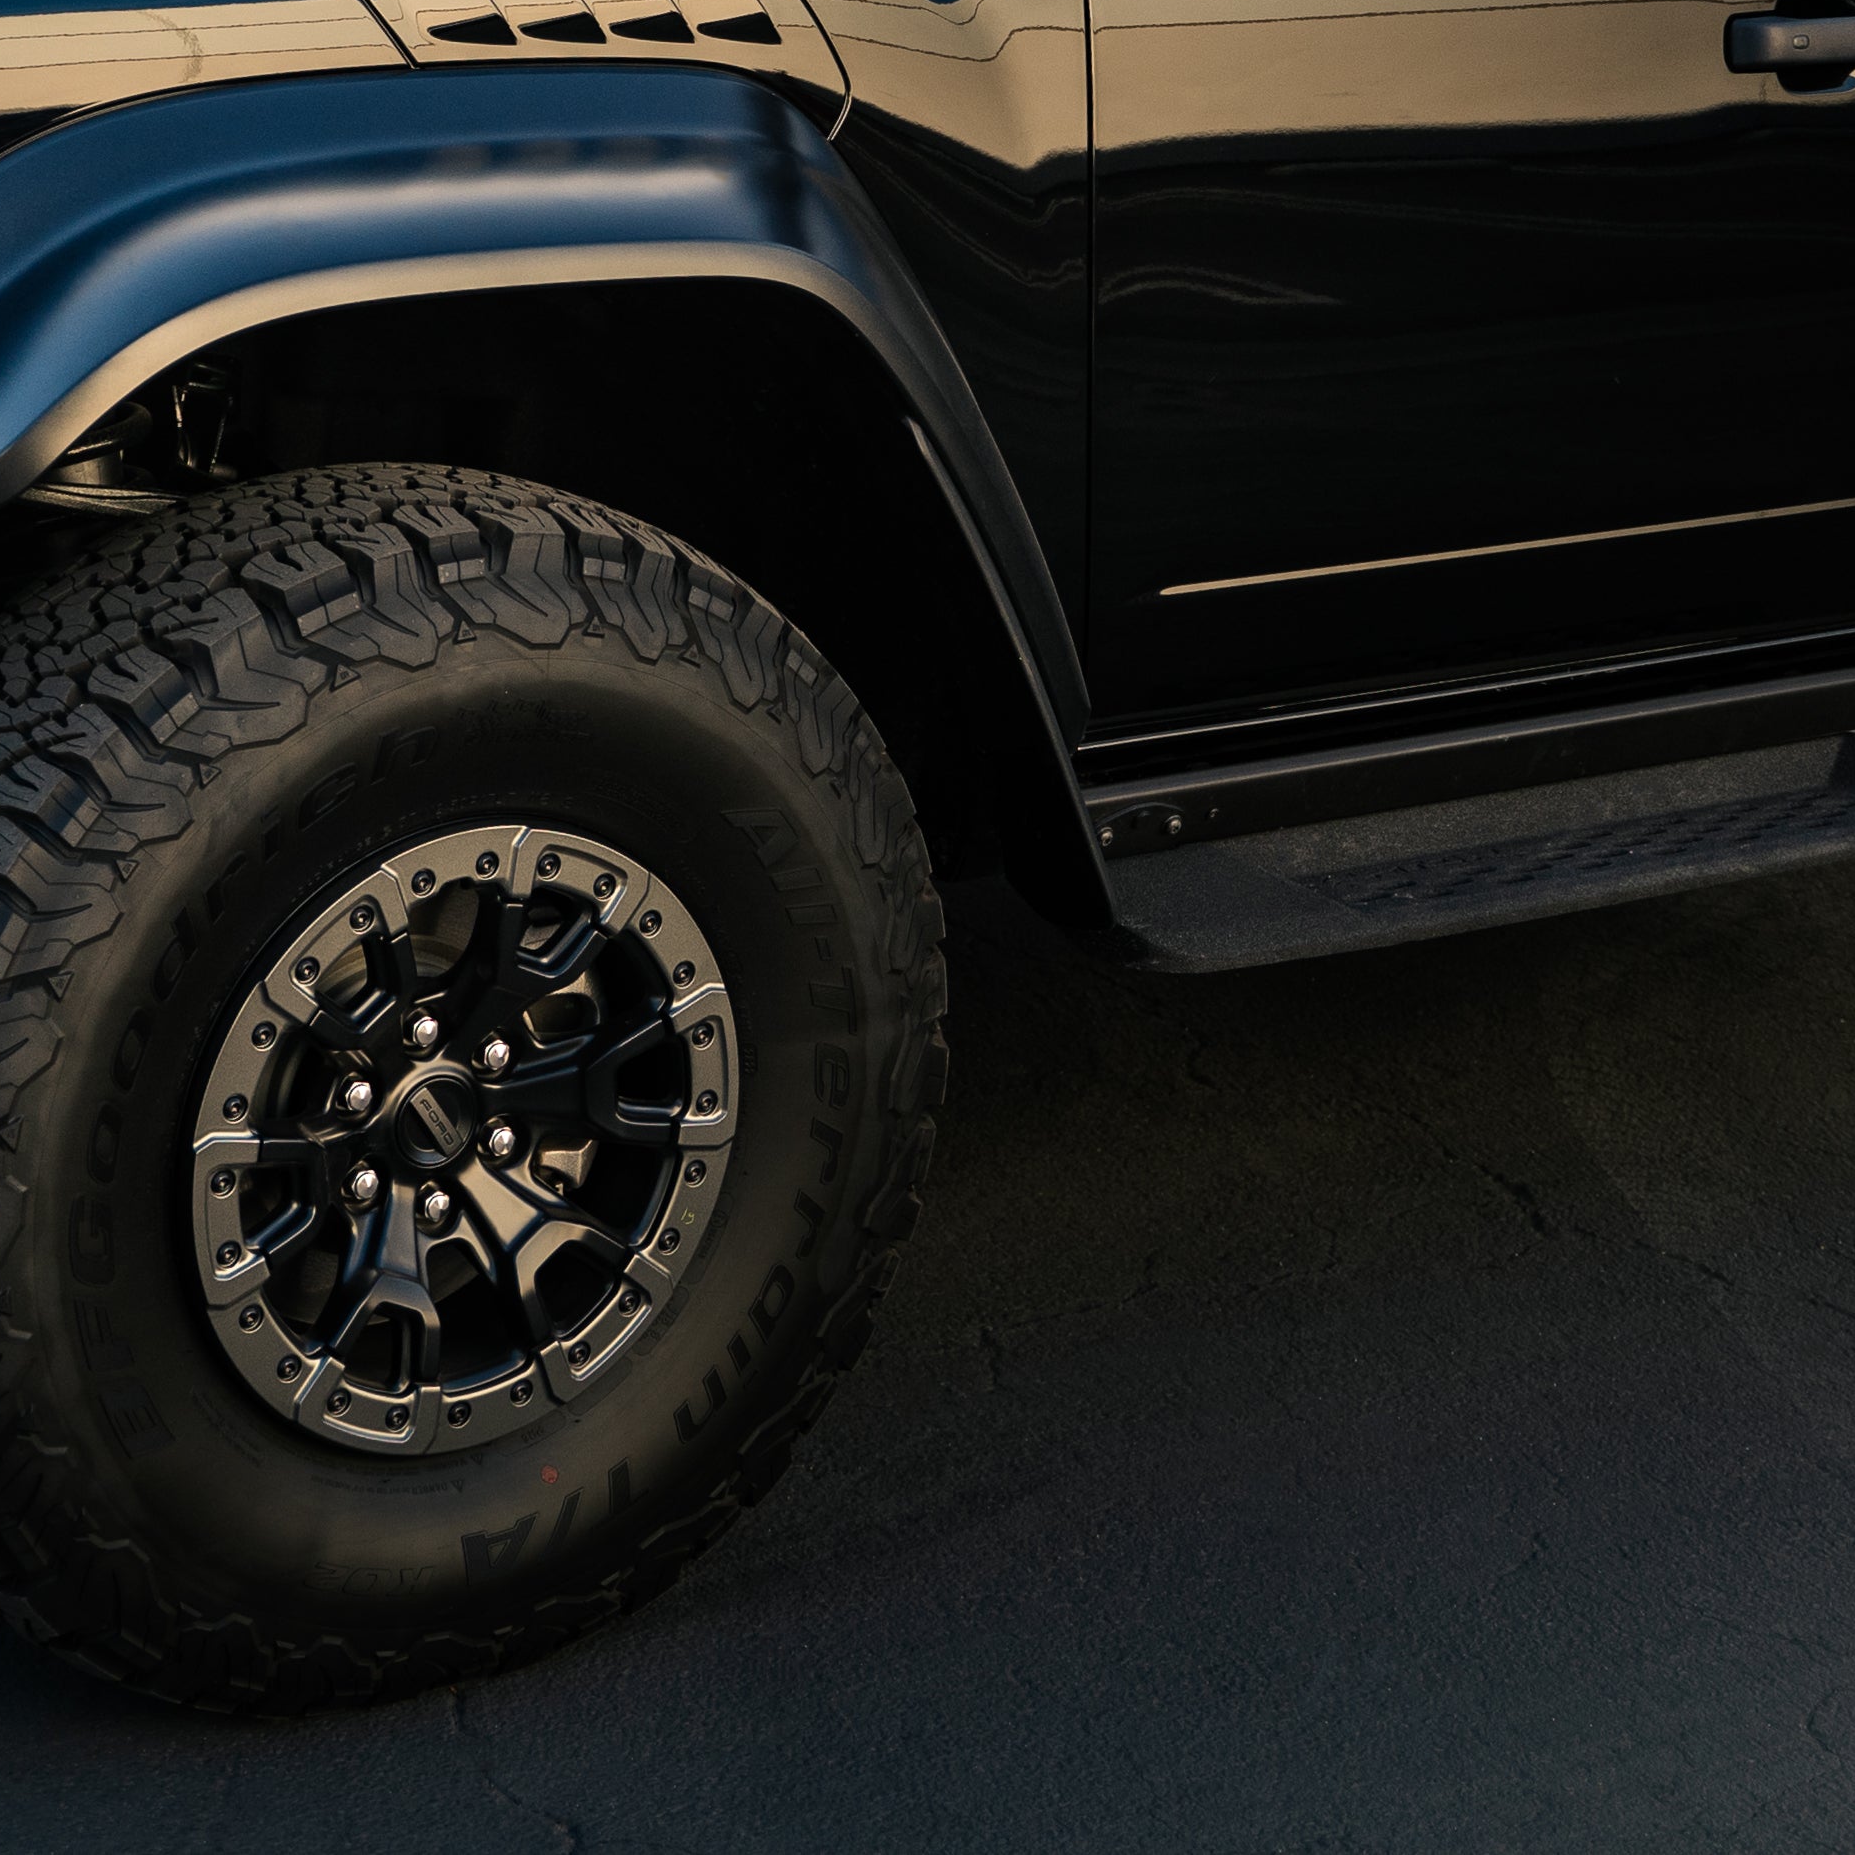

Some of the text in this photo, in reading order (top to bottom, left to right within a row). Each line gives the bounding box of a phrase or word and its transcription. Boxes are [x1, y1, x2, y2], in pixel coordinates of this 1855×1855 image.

[66, 723, 439, 1461] BFGoodrich
[418, 1097, 455, 1146] FORD
[675, 805, 859, 1448] All-Terrain
[460, 1457, 652, 1587] T/A
